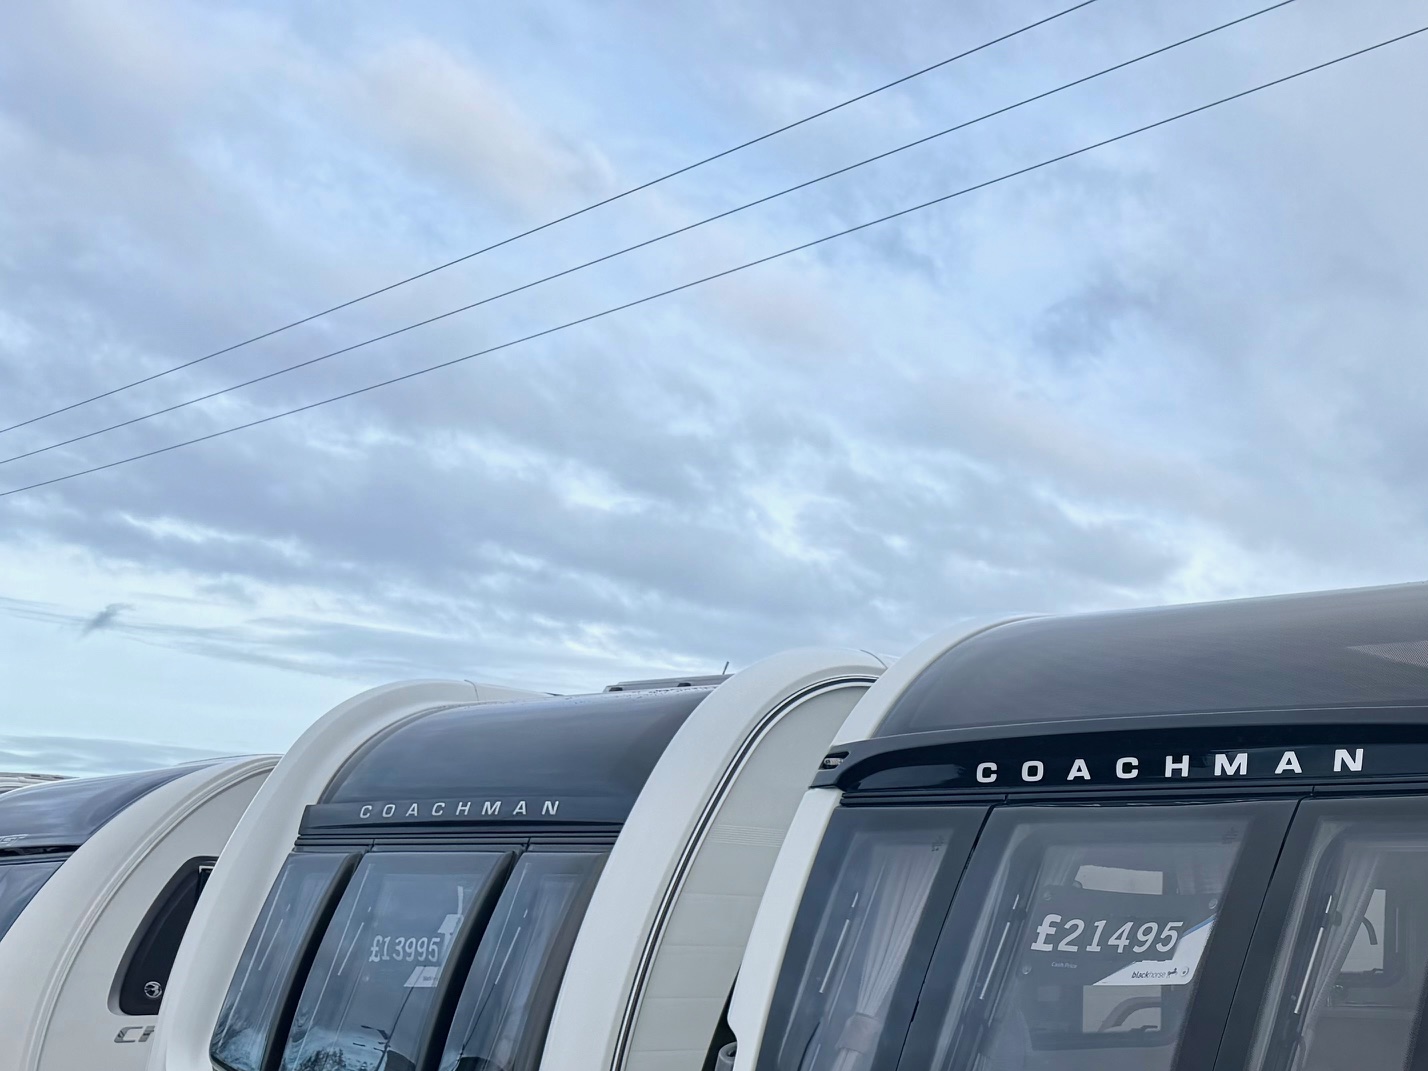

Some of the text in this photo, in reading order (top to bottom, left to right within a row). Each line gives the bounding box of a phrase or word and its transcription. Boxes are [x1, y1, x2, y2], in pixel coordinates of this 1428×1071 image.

[975, 748, 1364, 784] COACHMAN
[359, 800, 560, 819] COACHMAN
[368, 935, 441, 962] £13995
[1030, 914, 1184, 953] £21495
